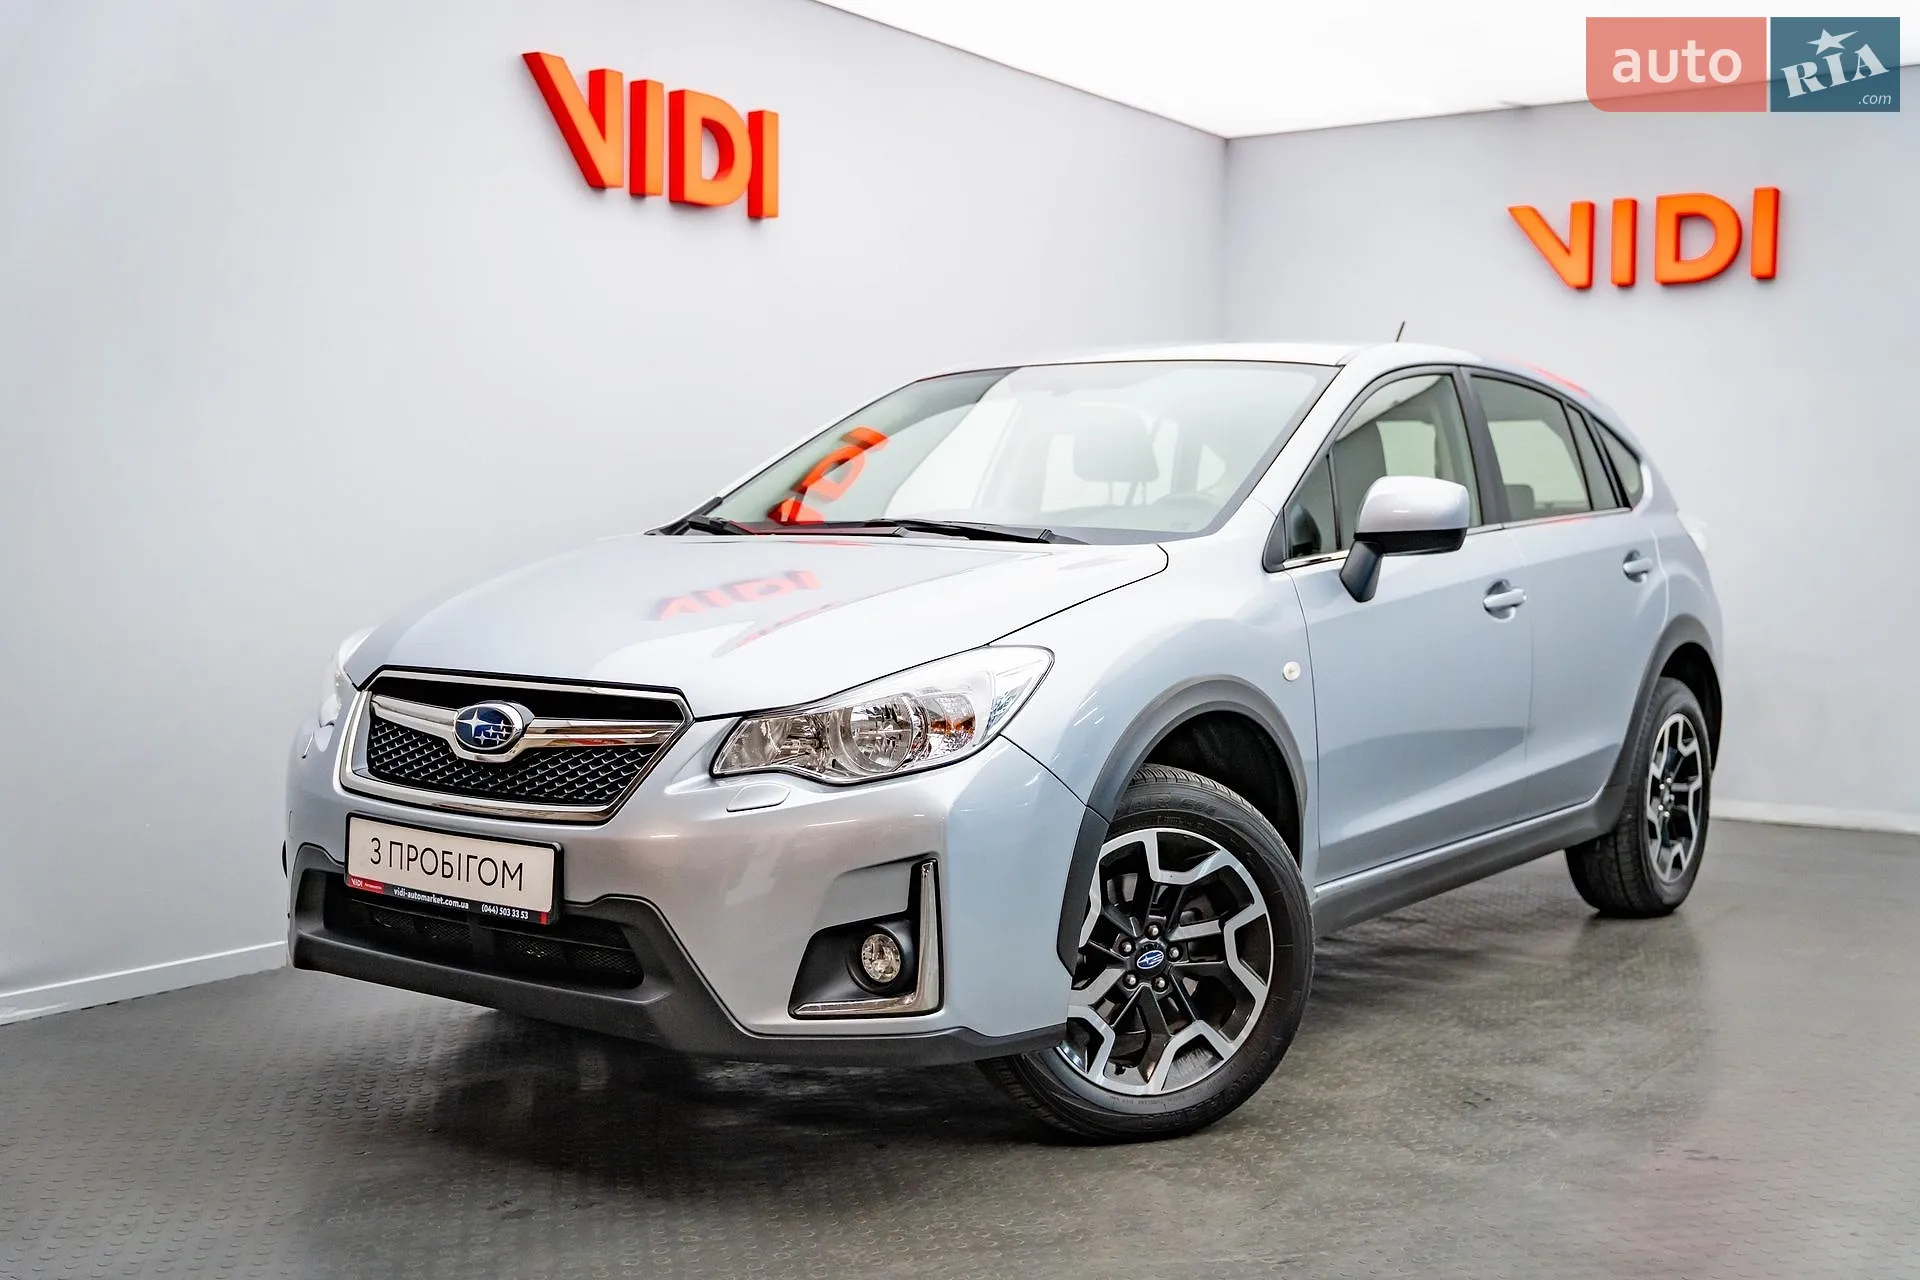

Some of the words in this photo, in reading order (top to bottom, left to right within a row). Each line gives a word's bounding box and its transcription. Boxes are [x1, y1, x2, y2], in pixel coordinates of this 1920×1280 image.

[521, 51, 779, 220] VIDI
[1507, 186, 1781, 290] VIDI
[389, 840, 523, 892] ПРОБІГОМ
[393, 887, 469, 909] vidi-automarket.com.ua
[481, 903, 499, 915] (044)
[499, 907, 511, 917] 503
[511, 909, 520, 918] 33
[520, 910, 529, 920] 53
